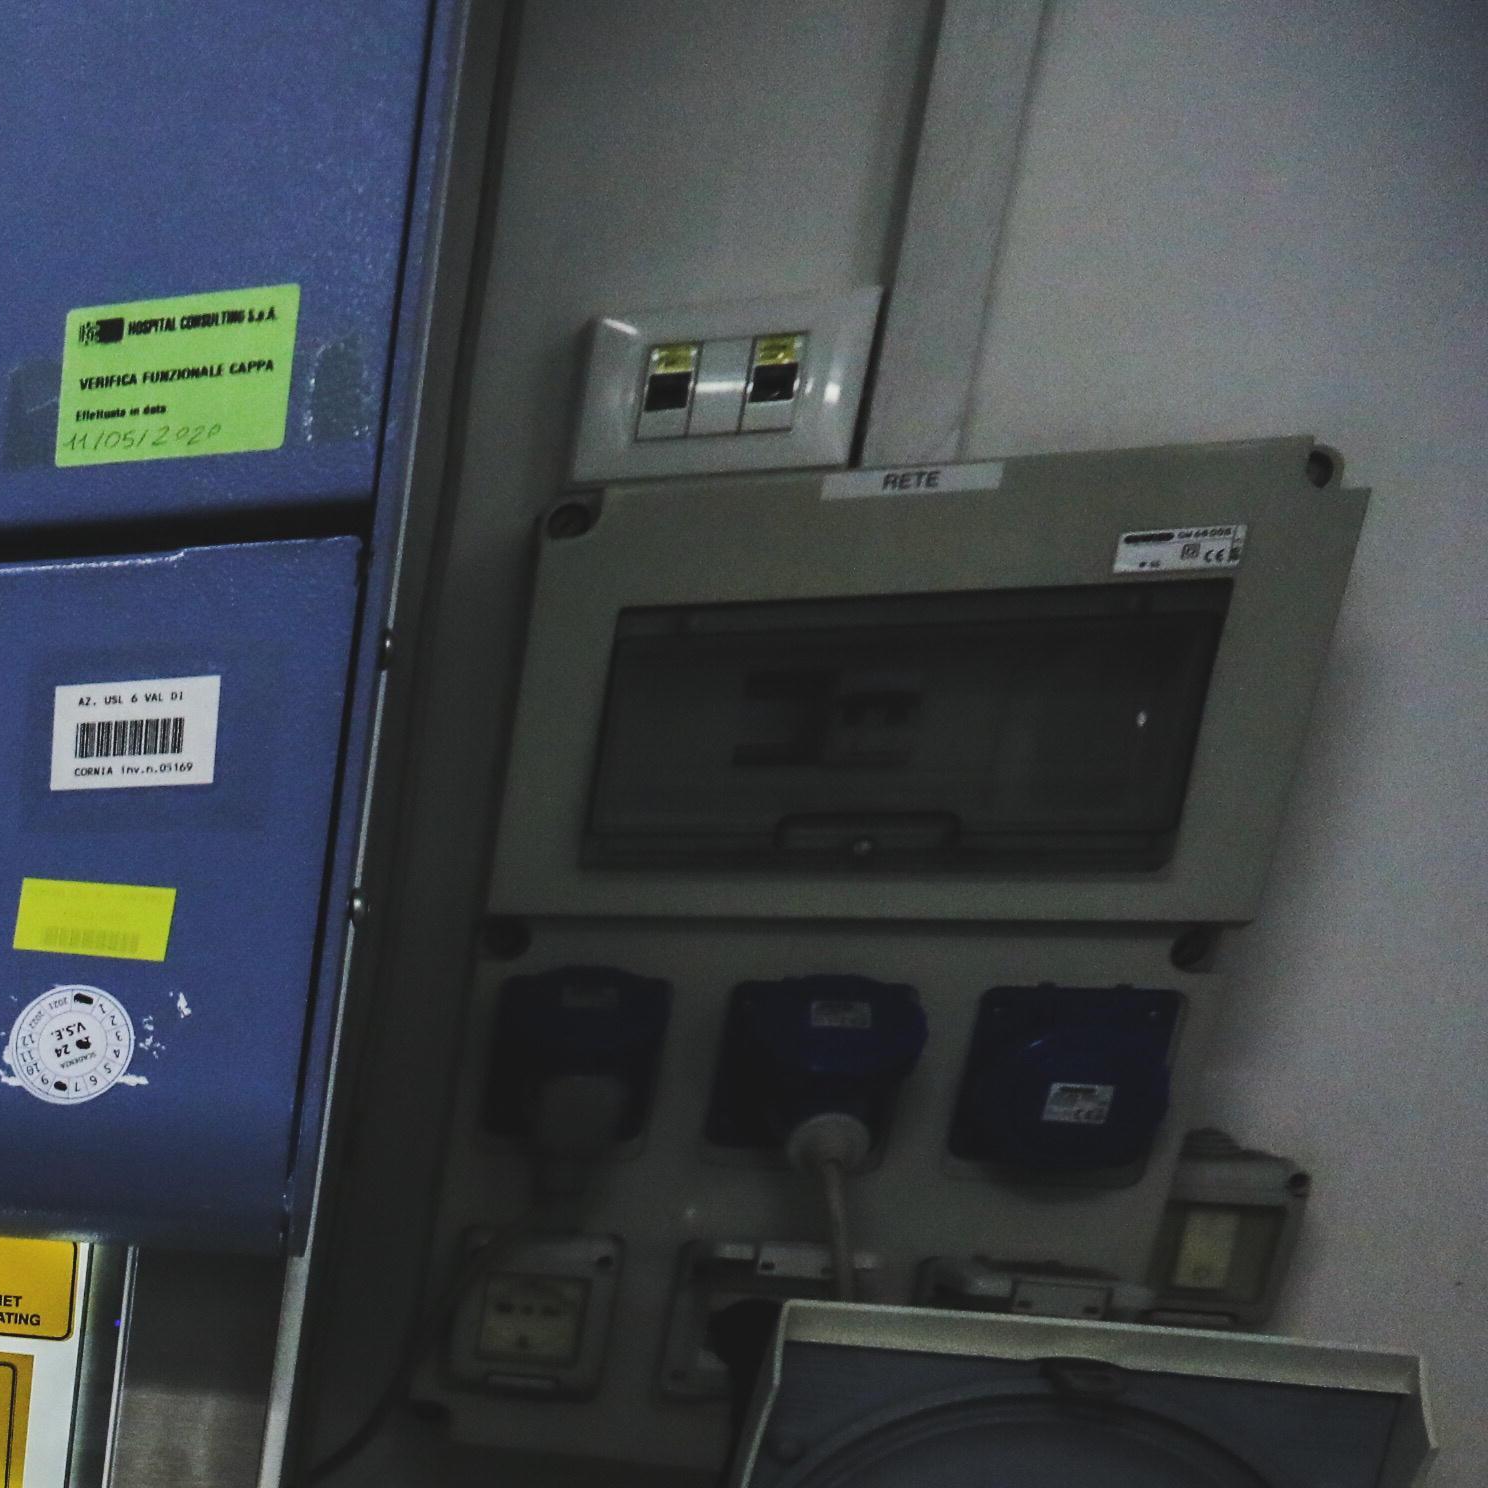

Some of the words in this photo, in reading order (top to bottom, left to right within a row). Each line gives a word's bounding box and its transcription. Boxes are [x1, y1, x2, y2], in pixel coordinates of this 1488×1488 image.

[128, 317, 176, 335] HOSPITAL
[180, 309, 245, 330] CONSULTING
[79, 373, 138, 391] VERIFICA
[143, 363, 224, 384] FUNZIONALE
[229, 359, 274, 375] CAPPA
[130, 406, 140, 416] in
[143, 404, 167, 415] data
[882, 470, 941, 491] RETE
[104, 695, 123, 705] USL
[131, 693, 138, 703] 6
[145, 692, 163, 703] VAL
[171, 690, 184, 701] DI
[74, 765, 114, 777] CORNIA
[115, 1030, 123, 1041] 3
